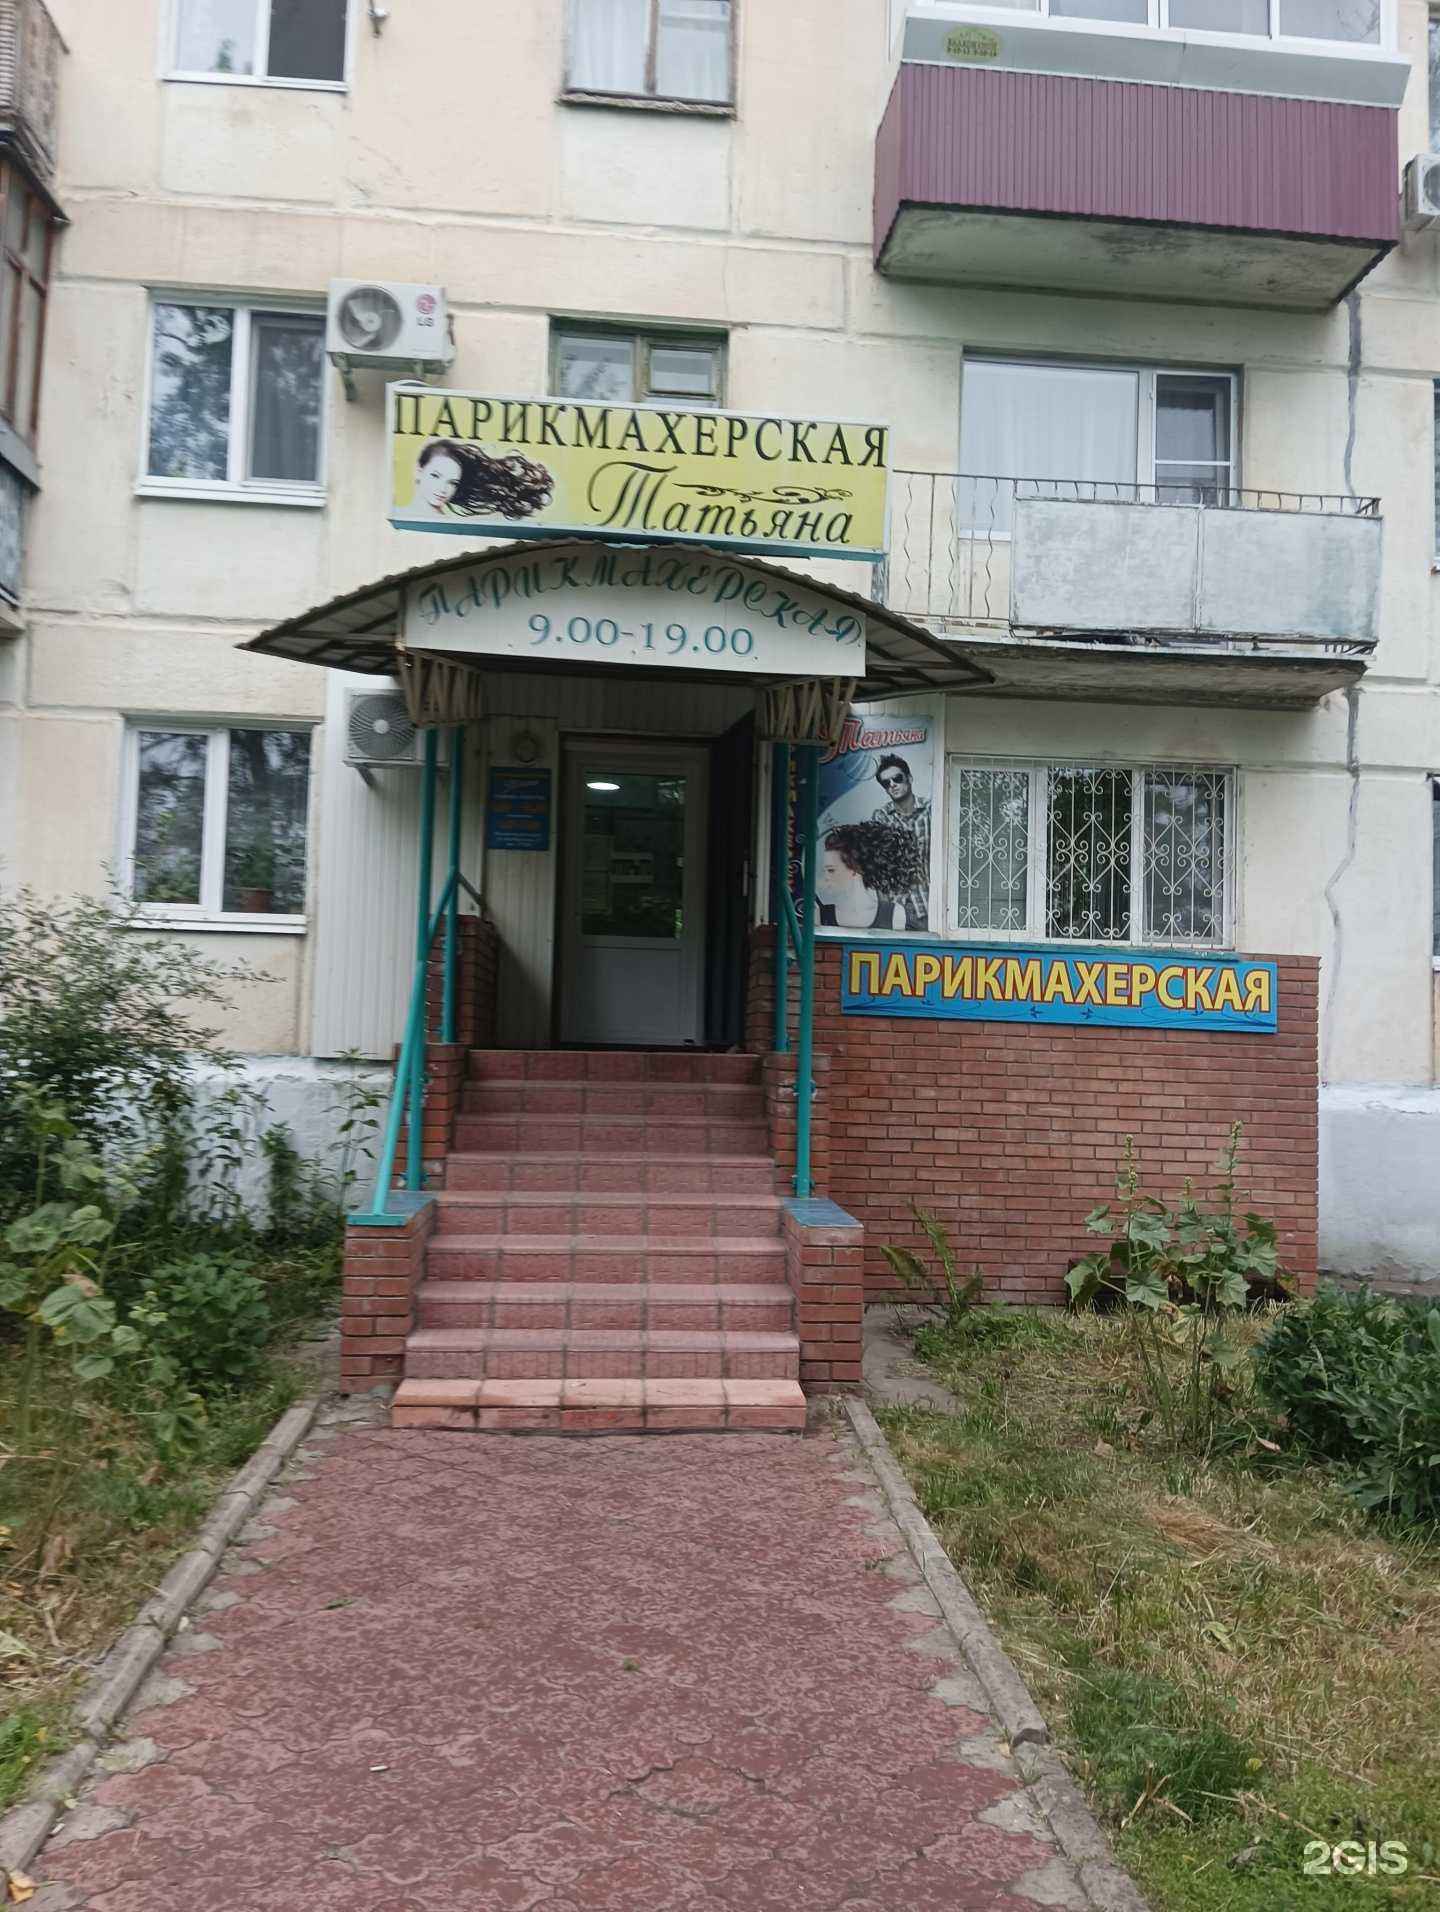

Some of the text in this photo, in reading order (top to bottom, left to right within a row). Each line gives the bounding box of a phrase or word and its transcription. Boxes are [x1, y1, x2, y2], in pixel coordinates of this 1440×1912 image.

[393, 393, 889, 468] ПАРИКМАХЕРСКАЯ
[586, 460, 854, 544] Татьяна
[528, 613, 754, 656] 9.00-19.00
[848, 949, 1273, 1014] ПАРИКМАХЕРСКАЯ
